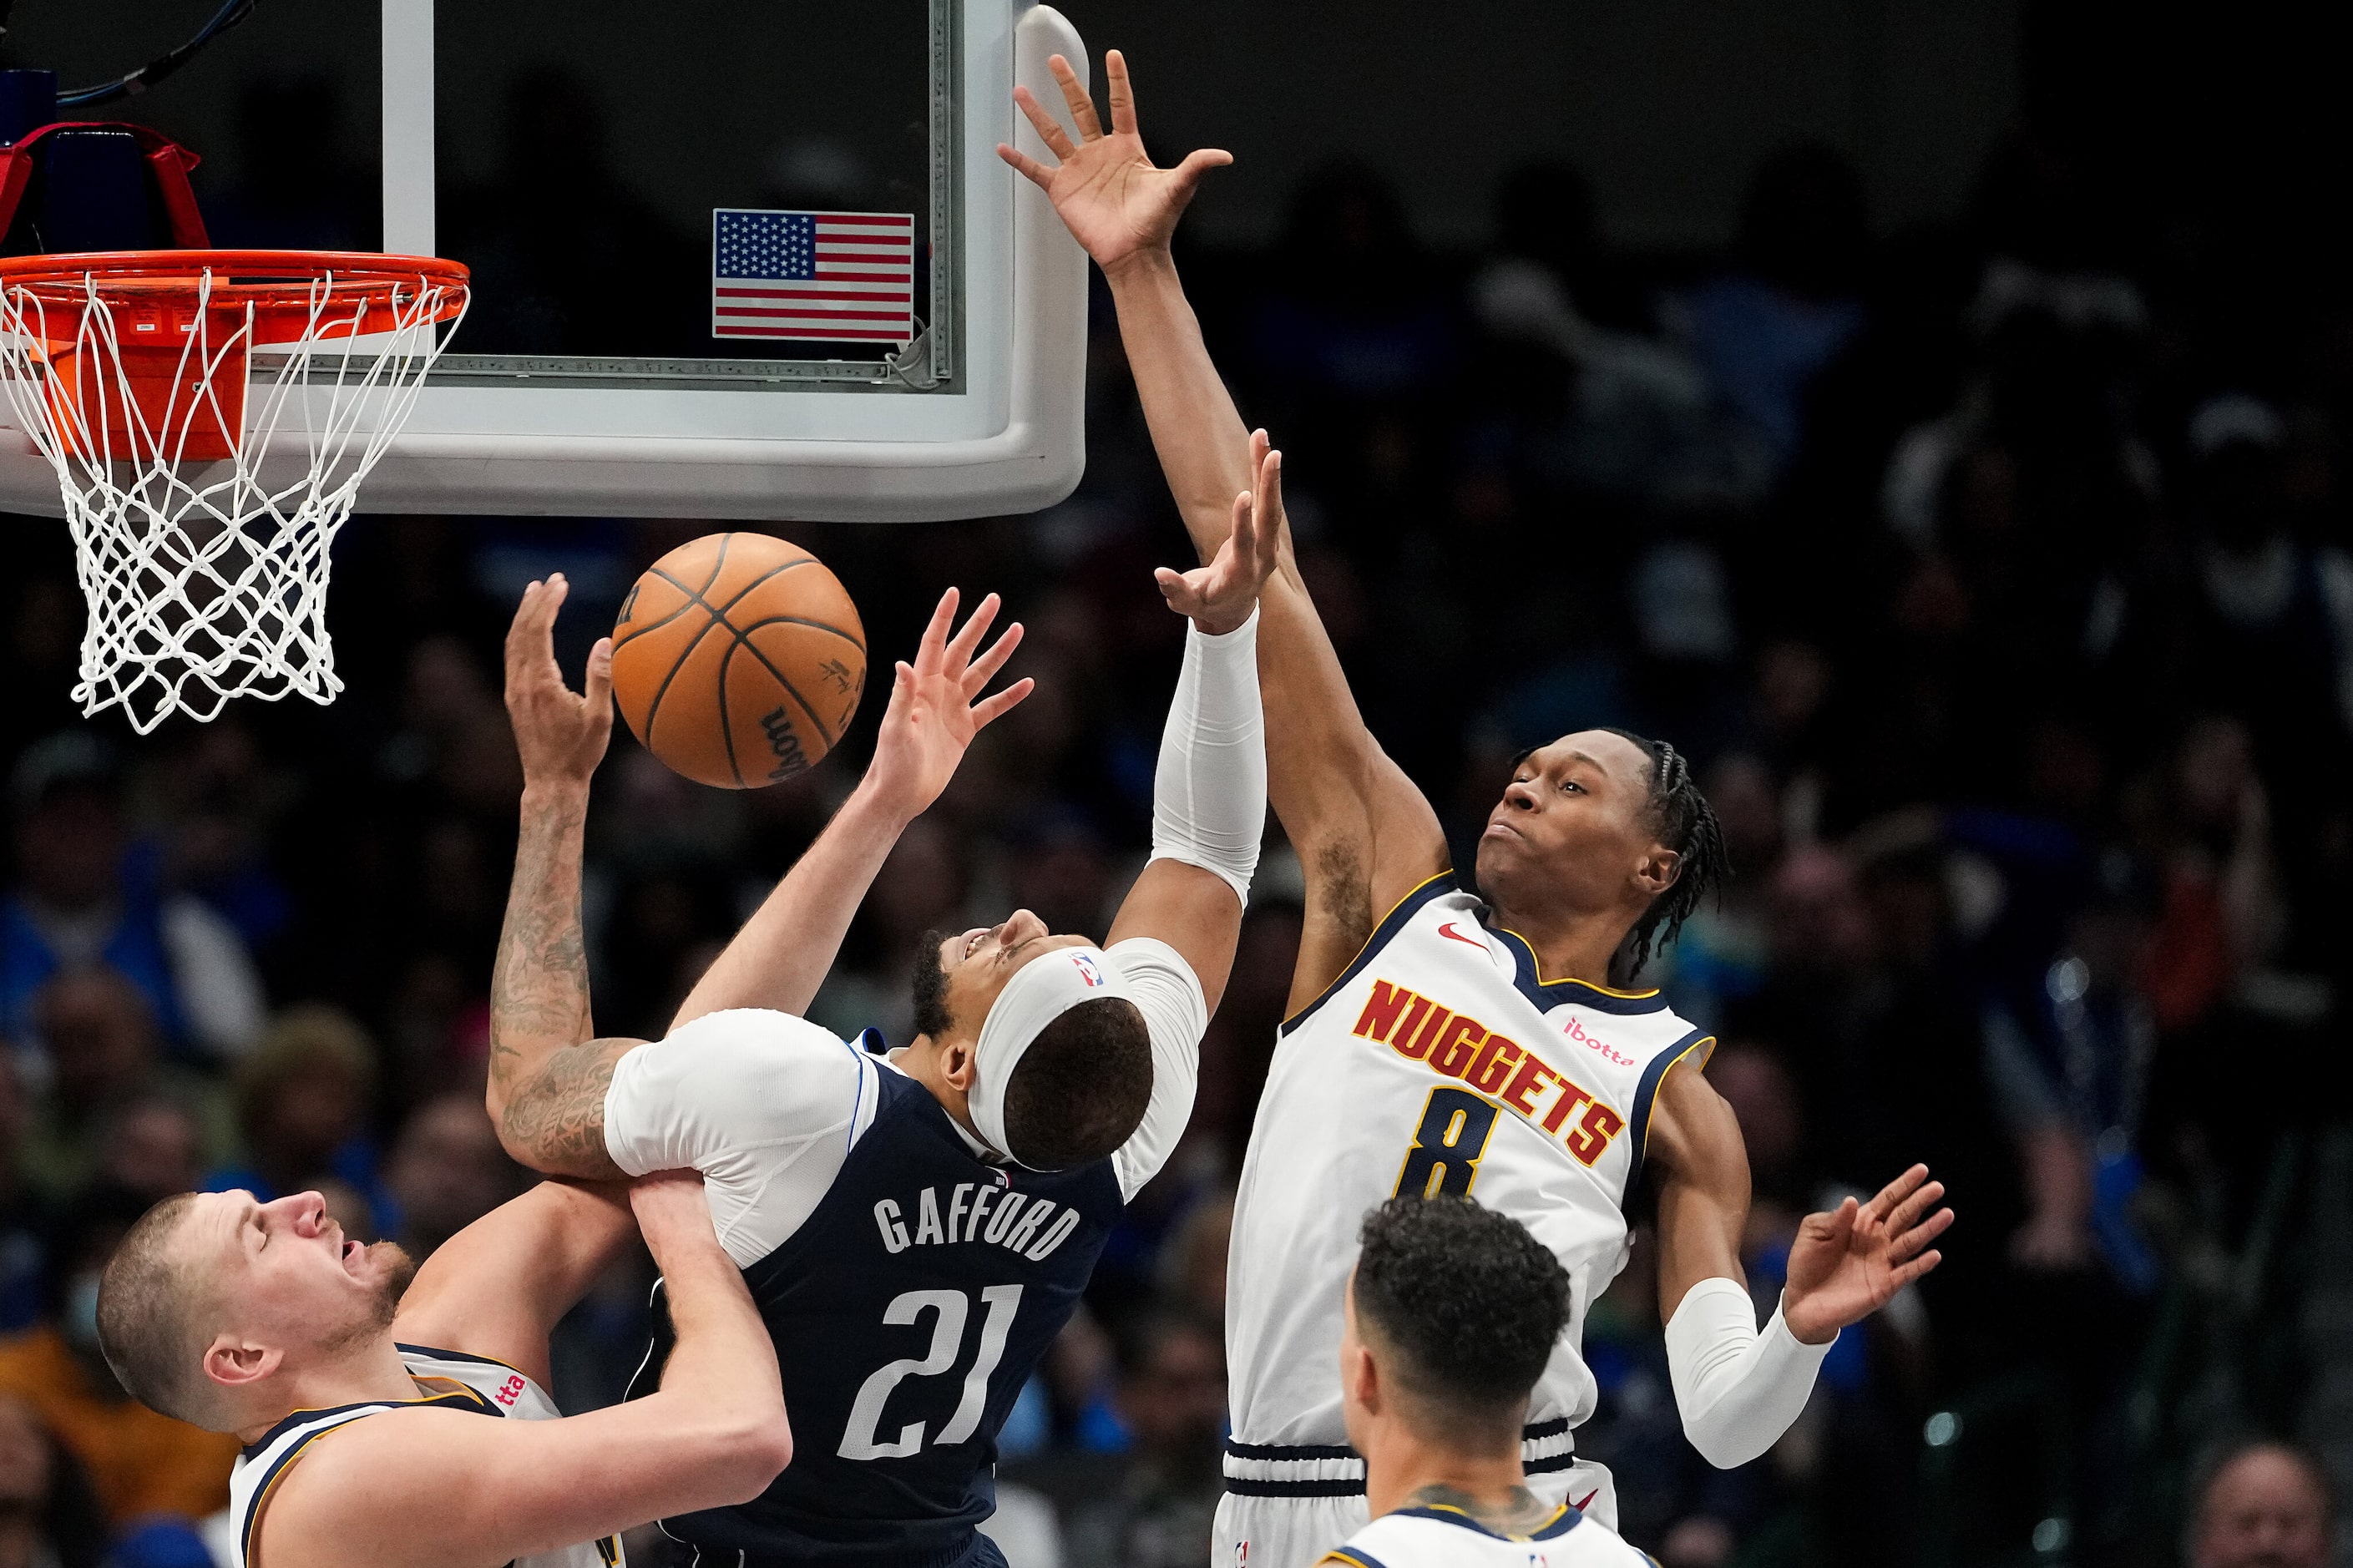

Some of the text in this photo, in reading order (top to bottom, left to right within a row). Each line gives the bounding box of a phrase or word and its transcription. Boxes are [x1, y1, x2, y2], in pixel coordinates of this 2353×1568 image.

[762, 706, 809, 778] lson
[1353, 979, 1625, 1168] NUGGETS
[1564, 1016, 1634, 1065] ibotta
[1392, 1085, 1503, 1201] 8
[874, 1183, 1080, 1261] GAFFORD
[494, 1375, 525, 1405] tta
[837, 1284, 1024, 1460] 21
